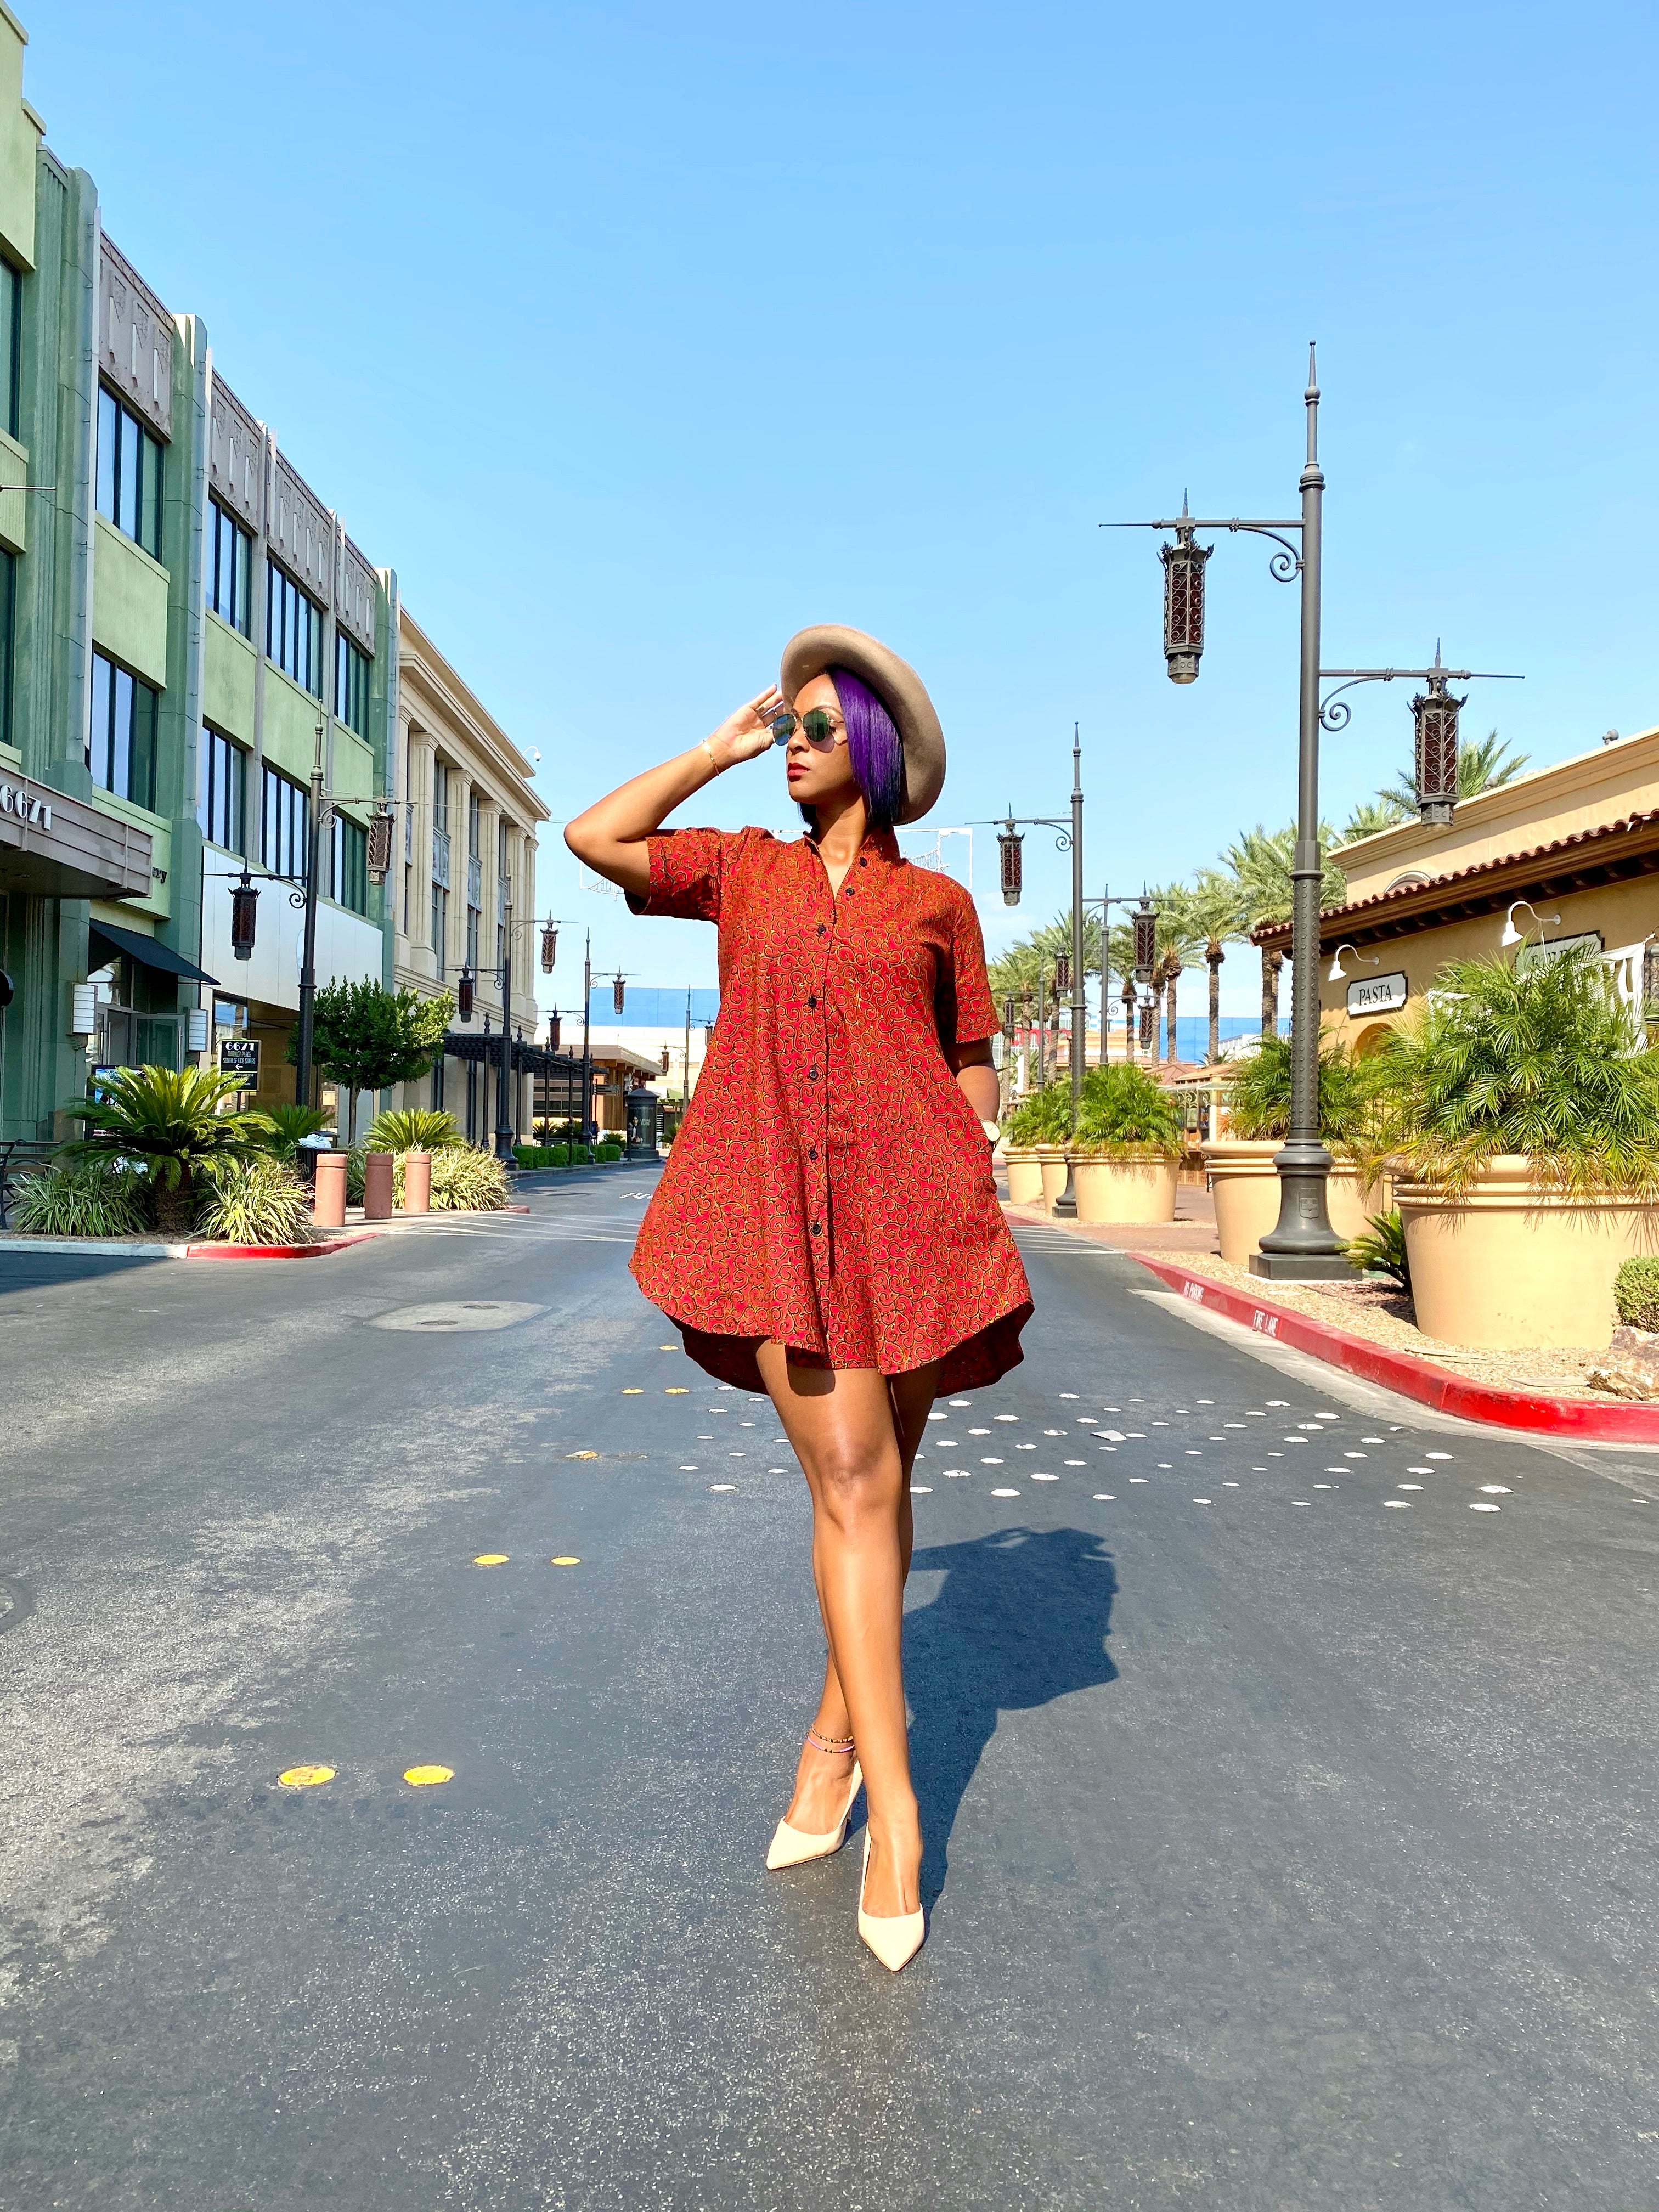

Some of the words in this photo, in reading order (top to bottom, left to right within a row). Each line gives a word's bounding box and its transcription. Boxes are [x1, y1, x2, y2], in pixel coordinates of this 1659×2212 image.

[0, 785, 52, 831] 6671
[1359, 984, 1392, 1006] PASTA
[225, 1042, 255, 1051] 6671
[1183, 1280, 1190, 1296] NO
[1189, 1282, 1204, 1302] PARKING
[1252, 1309, 1265, 1330] FIRE
[1265, 1314, 1279, 1337] LANE
